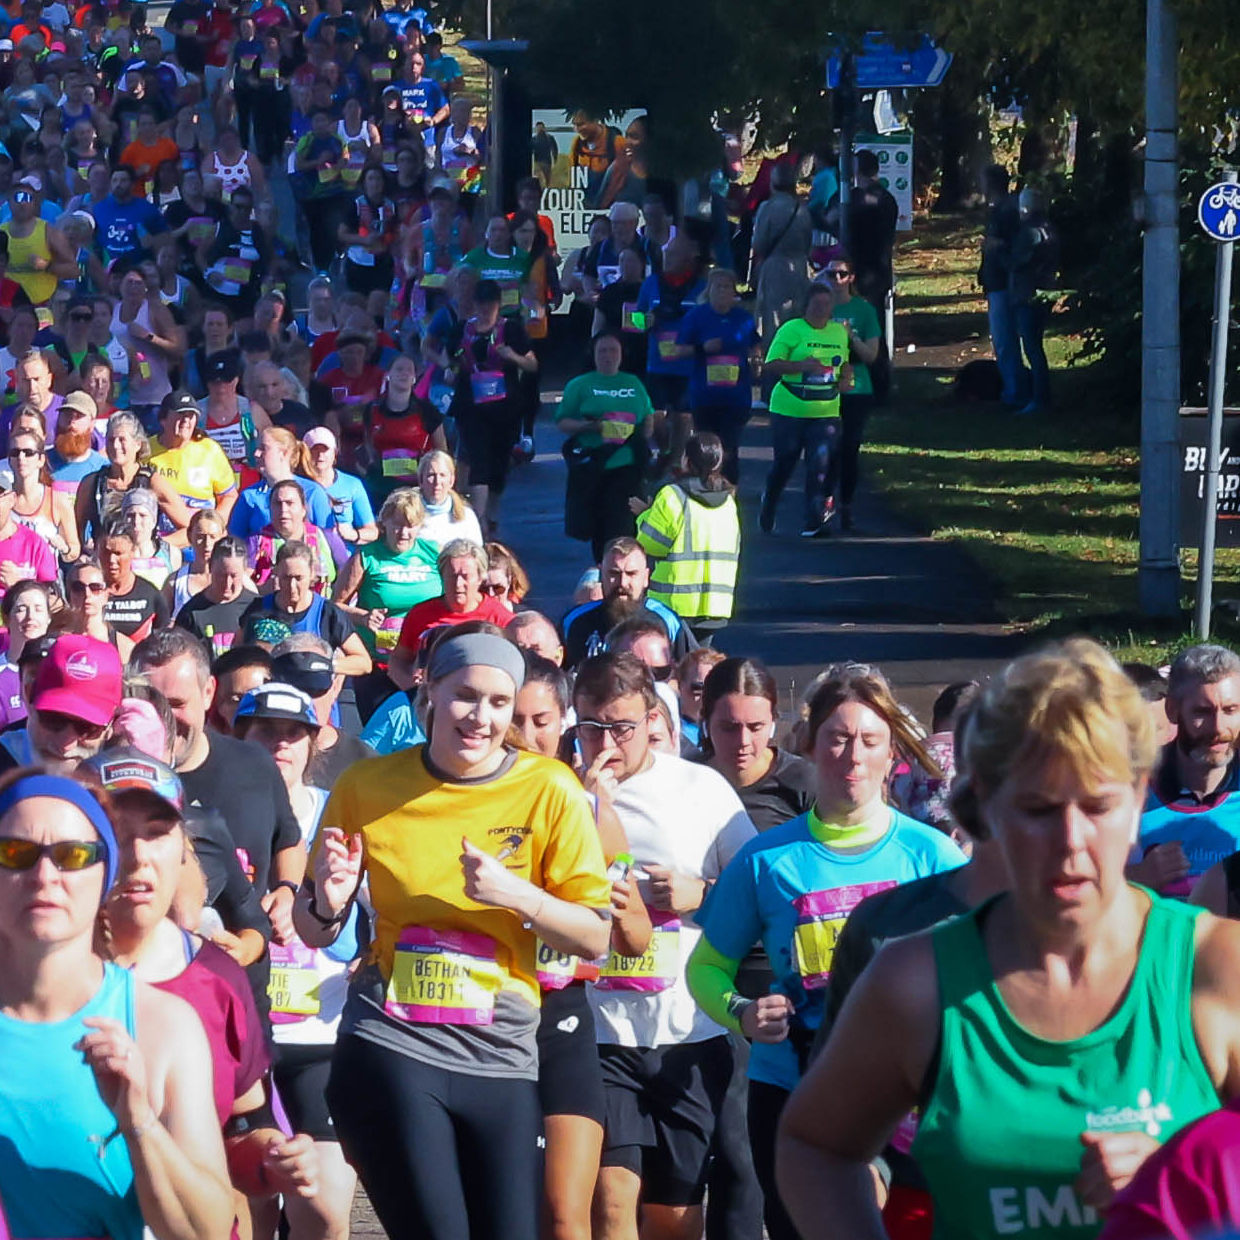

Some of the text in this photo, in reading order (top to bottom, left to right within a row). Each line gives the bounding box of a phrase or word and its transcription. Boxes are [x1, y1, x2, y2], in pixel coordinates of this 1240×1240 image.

[571, 166, 588, 188] IN
[540, 188, 585, 210] YOUR
[103, 613, 142, 621] ARRIERS
[415, 959, 471, 978] BETHAN
[989, 1184, 1098, 1235] EM
